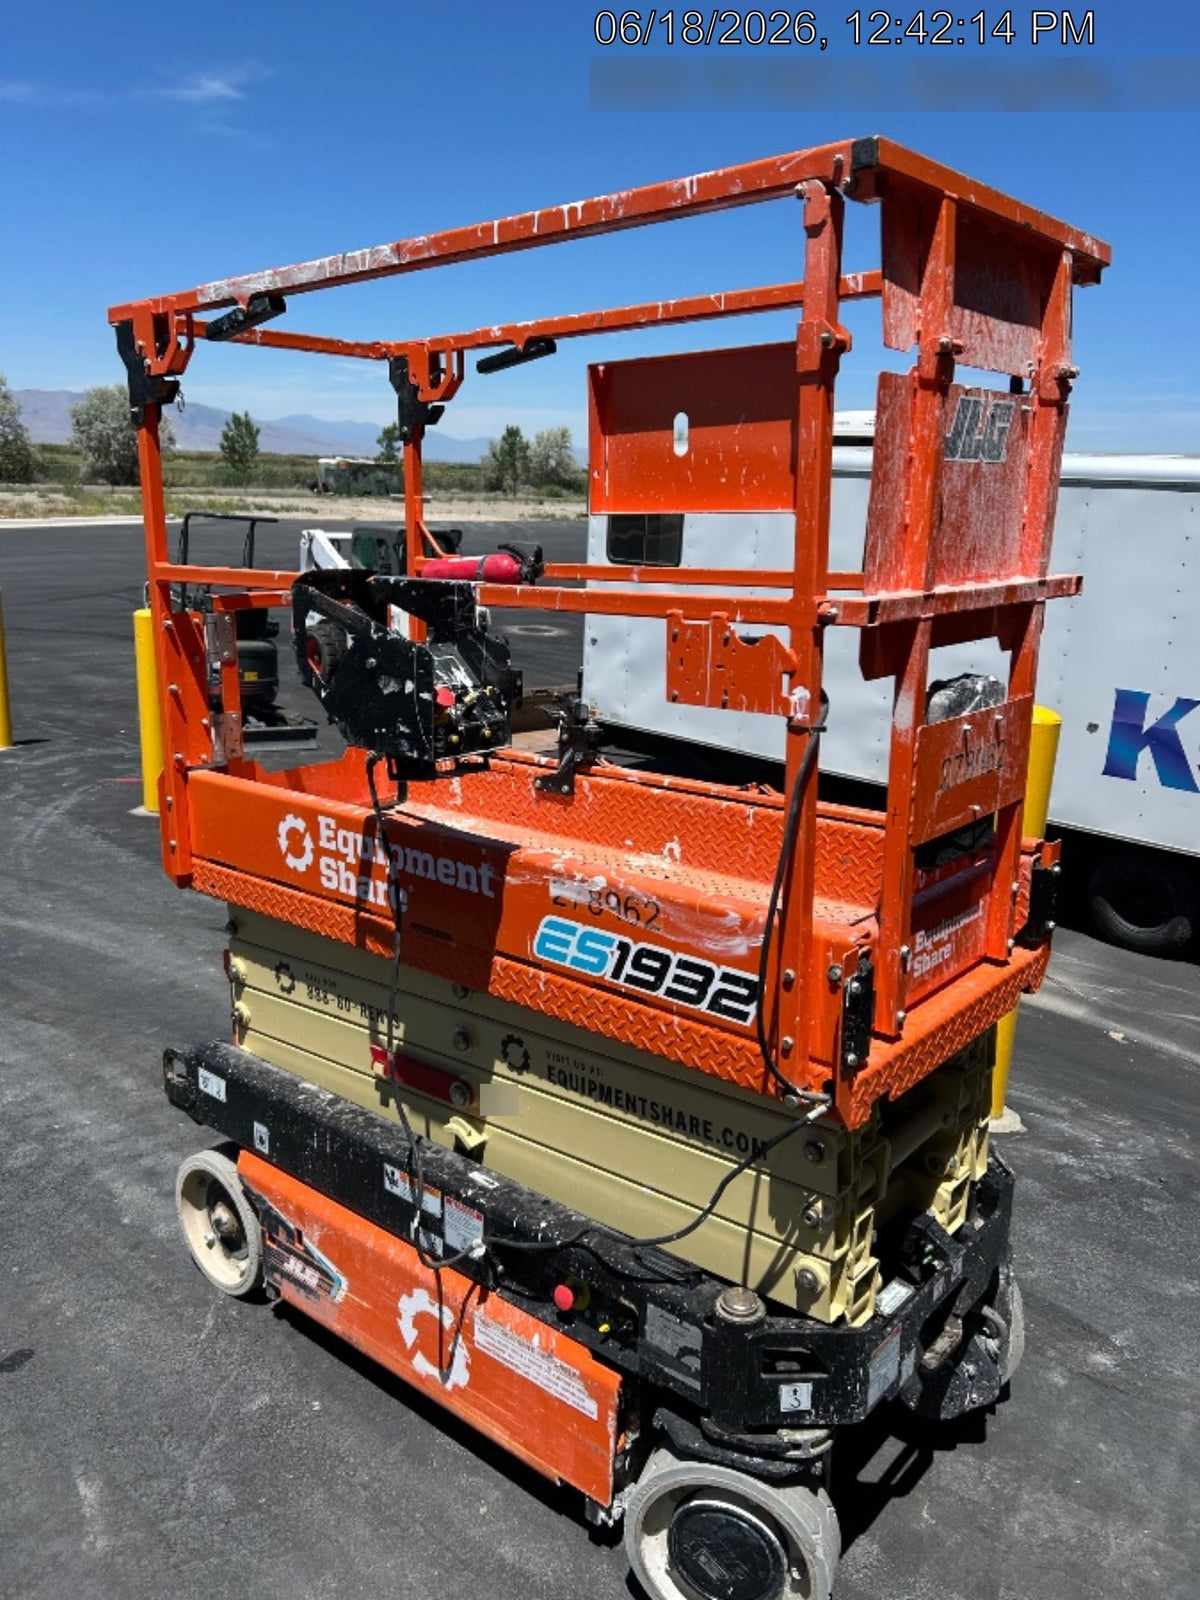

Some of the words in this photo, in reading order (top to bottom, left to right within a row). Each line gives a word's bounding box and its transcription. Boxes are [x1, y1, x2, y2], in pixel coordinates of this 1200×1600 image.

[944, 396, 1016, 463] JLG
[318, 815, 496, 898] Equipment
[319, 856, 408, 913] Share
[534, 915, 760, 1026] ES1932
[912, 943, 952, 978] Share
[546, 1063, 769, 1162] EQUIPMENTSHARE.COM
